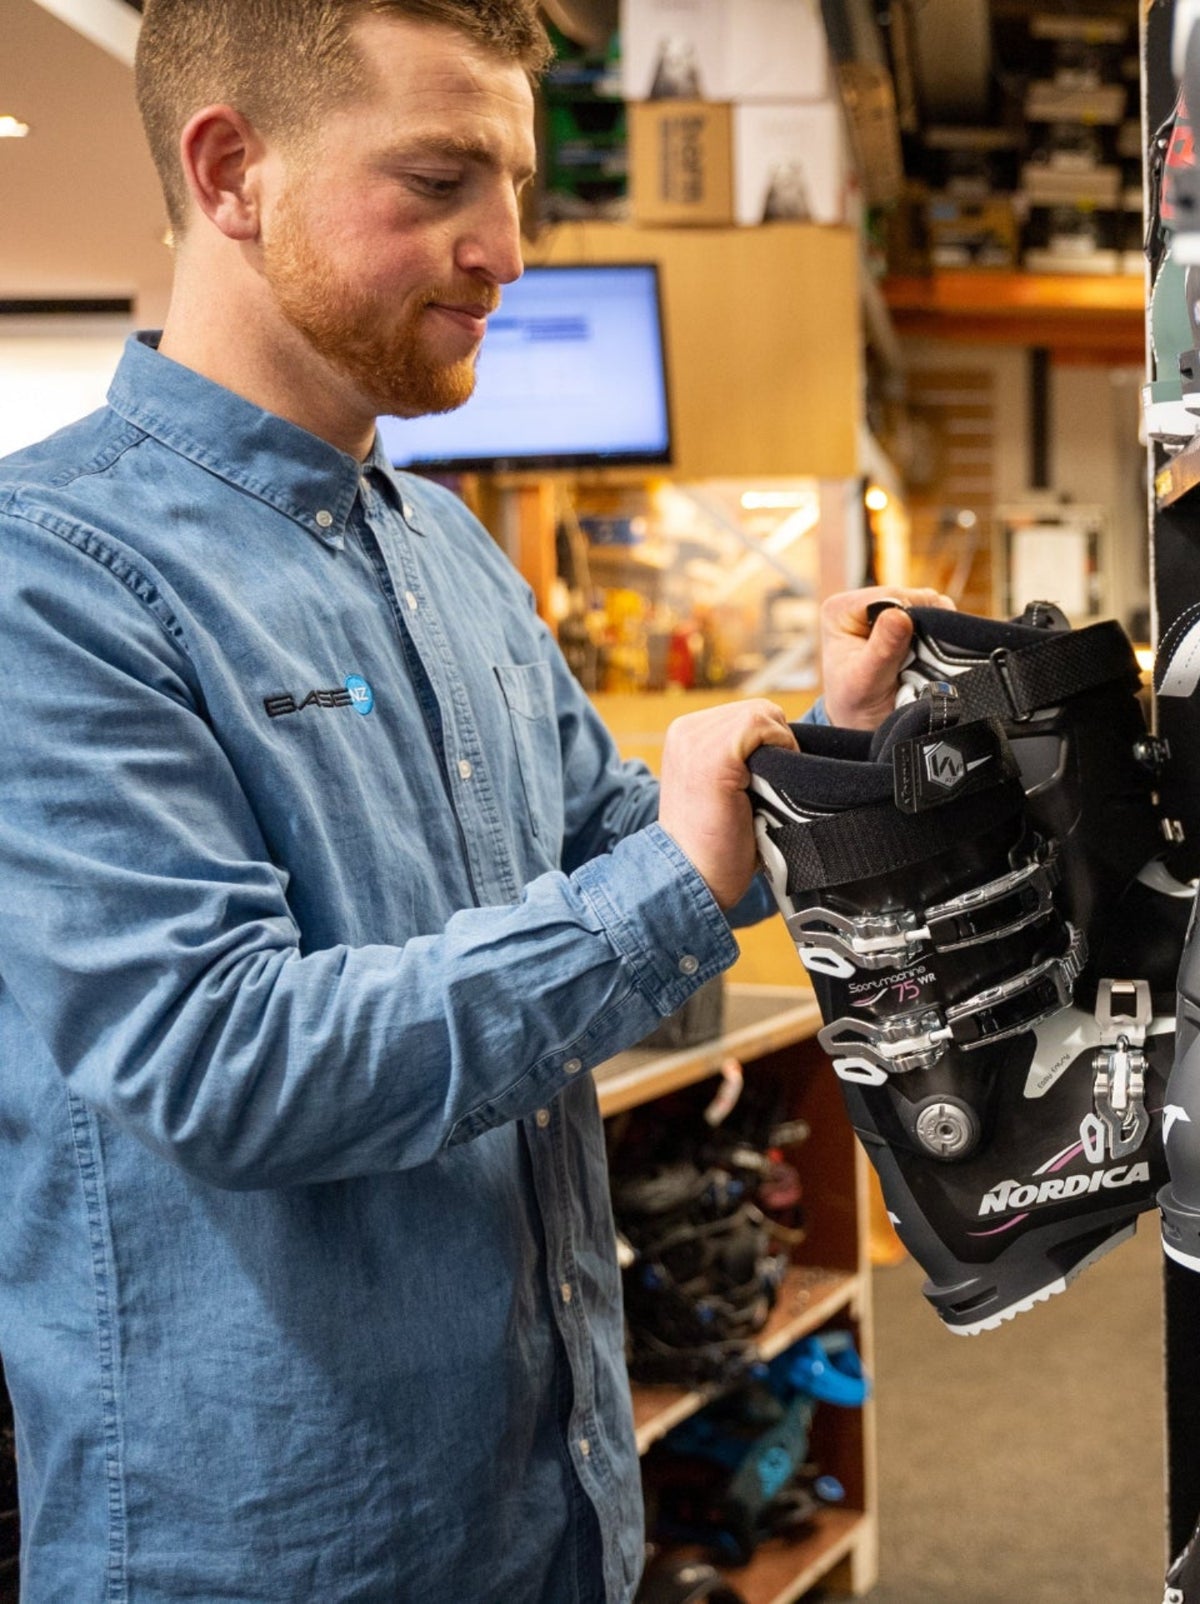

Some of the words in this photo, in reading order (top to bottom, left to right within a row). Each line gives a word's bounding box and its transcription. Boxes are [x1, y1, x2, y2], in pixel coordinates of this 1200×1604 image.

[263, 687, 354, 718] BASE
[348, 686, 369, 702] NZ
[848, 965, 926, 993] Sportmachine
[891, 979, 919, 1003] 75
[917, 972, 936, 985] WR
[1037, 1073, 1053, 1089] Easy
[978, 1161, 1150, 1216] NORDICA
